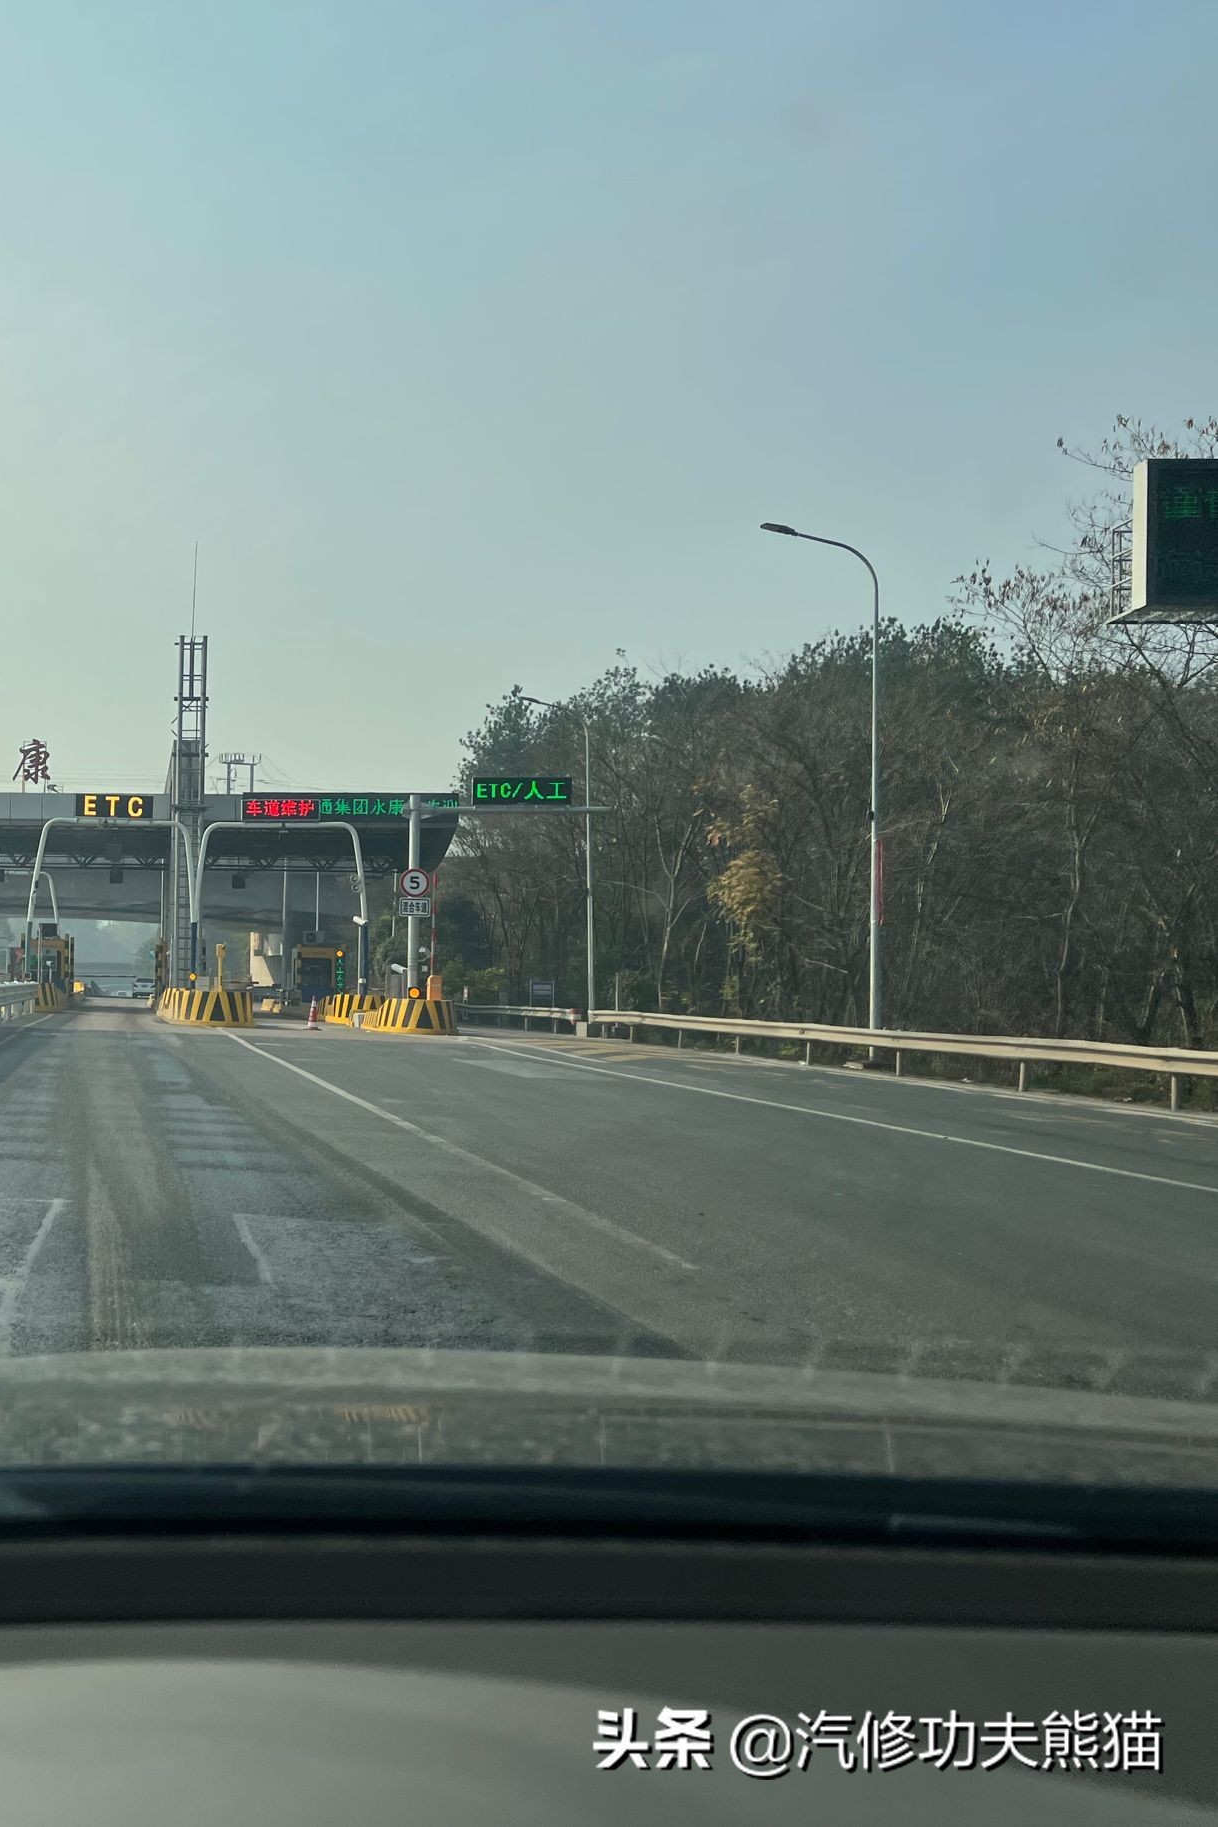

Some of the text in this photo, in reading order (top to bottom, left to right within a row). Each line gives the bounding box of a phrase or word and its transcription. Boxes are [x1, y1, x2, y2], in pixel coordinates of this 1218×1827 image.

[476, 780, 568, 800] ETC/人工
[84, 794, 143, 817] ETC
[246, 799, 315, 817] 车道维护
[409, 876, 421, 890] 5
[402, 901, 428, 913] 混合车道
